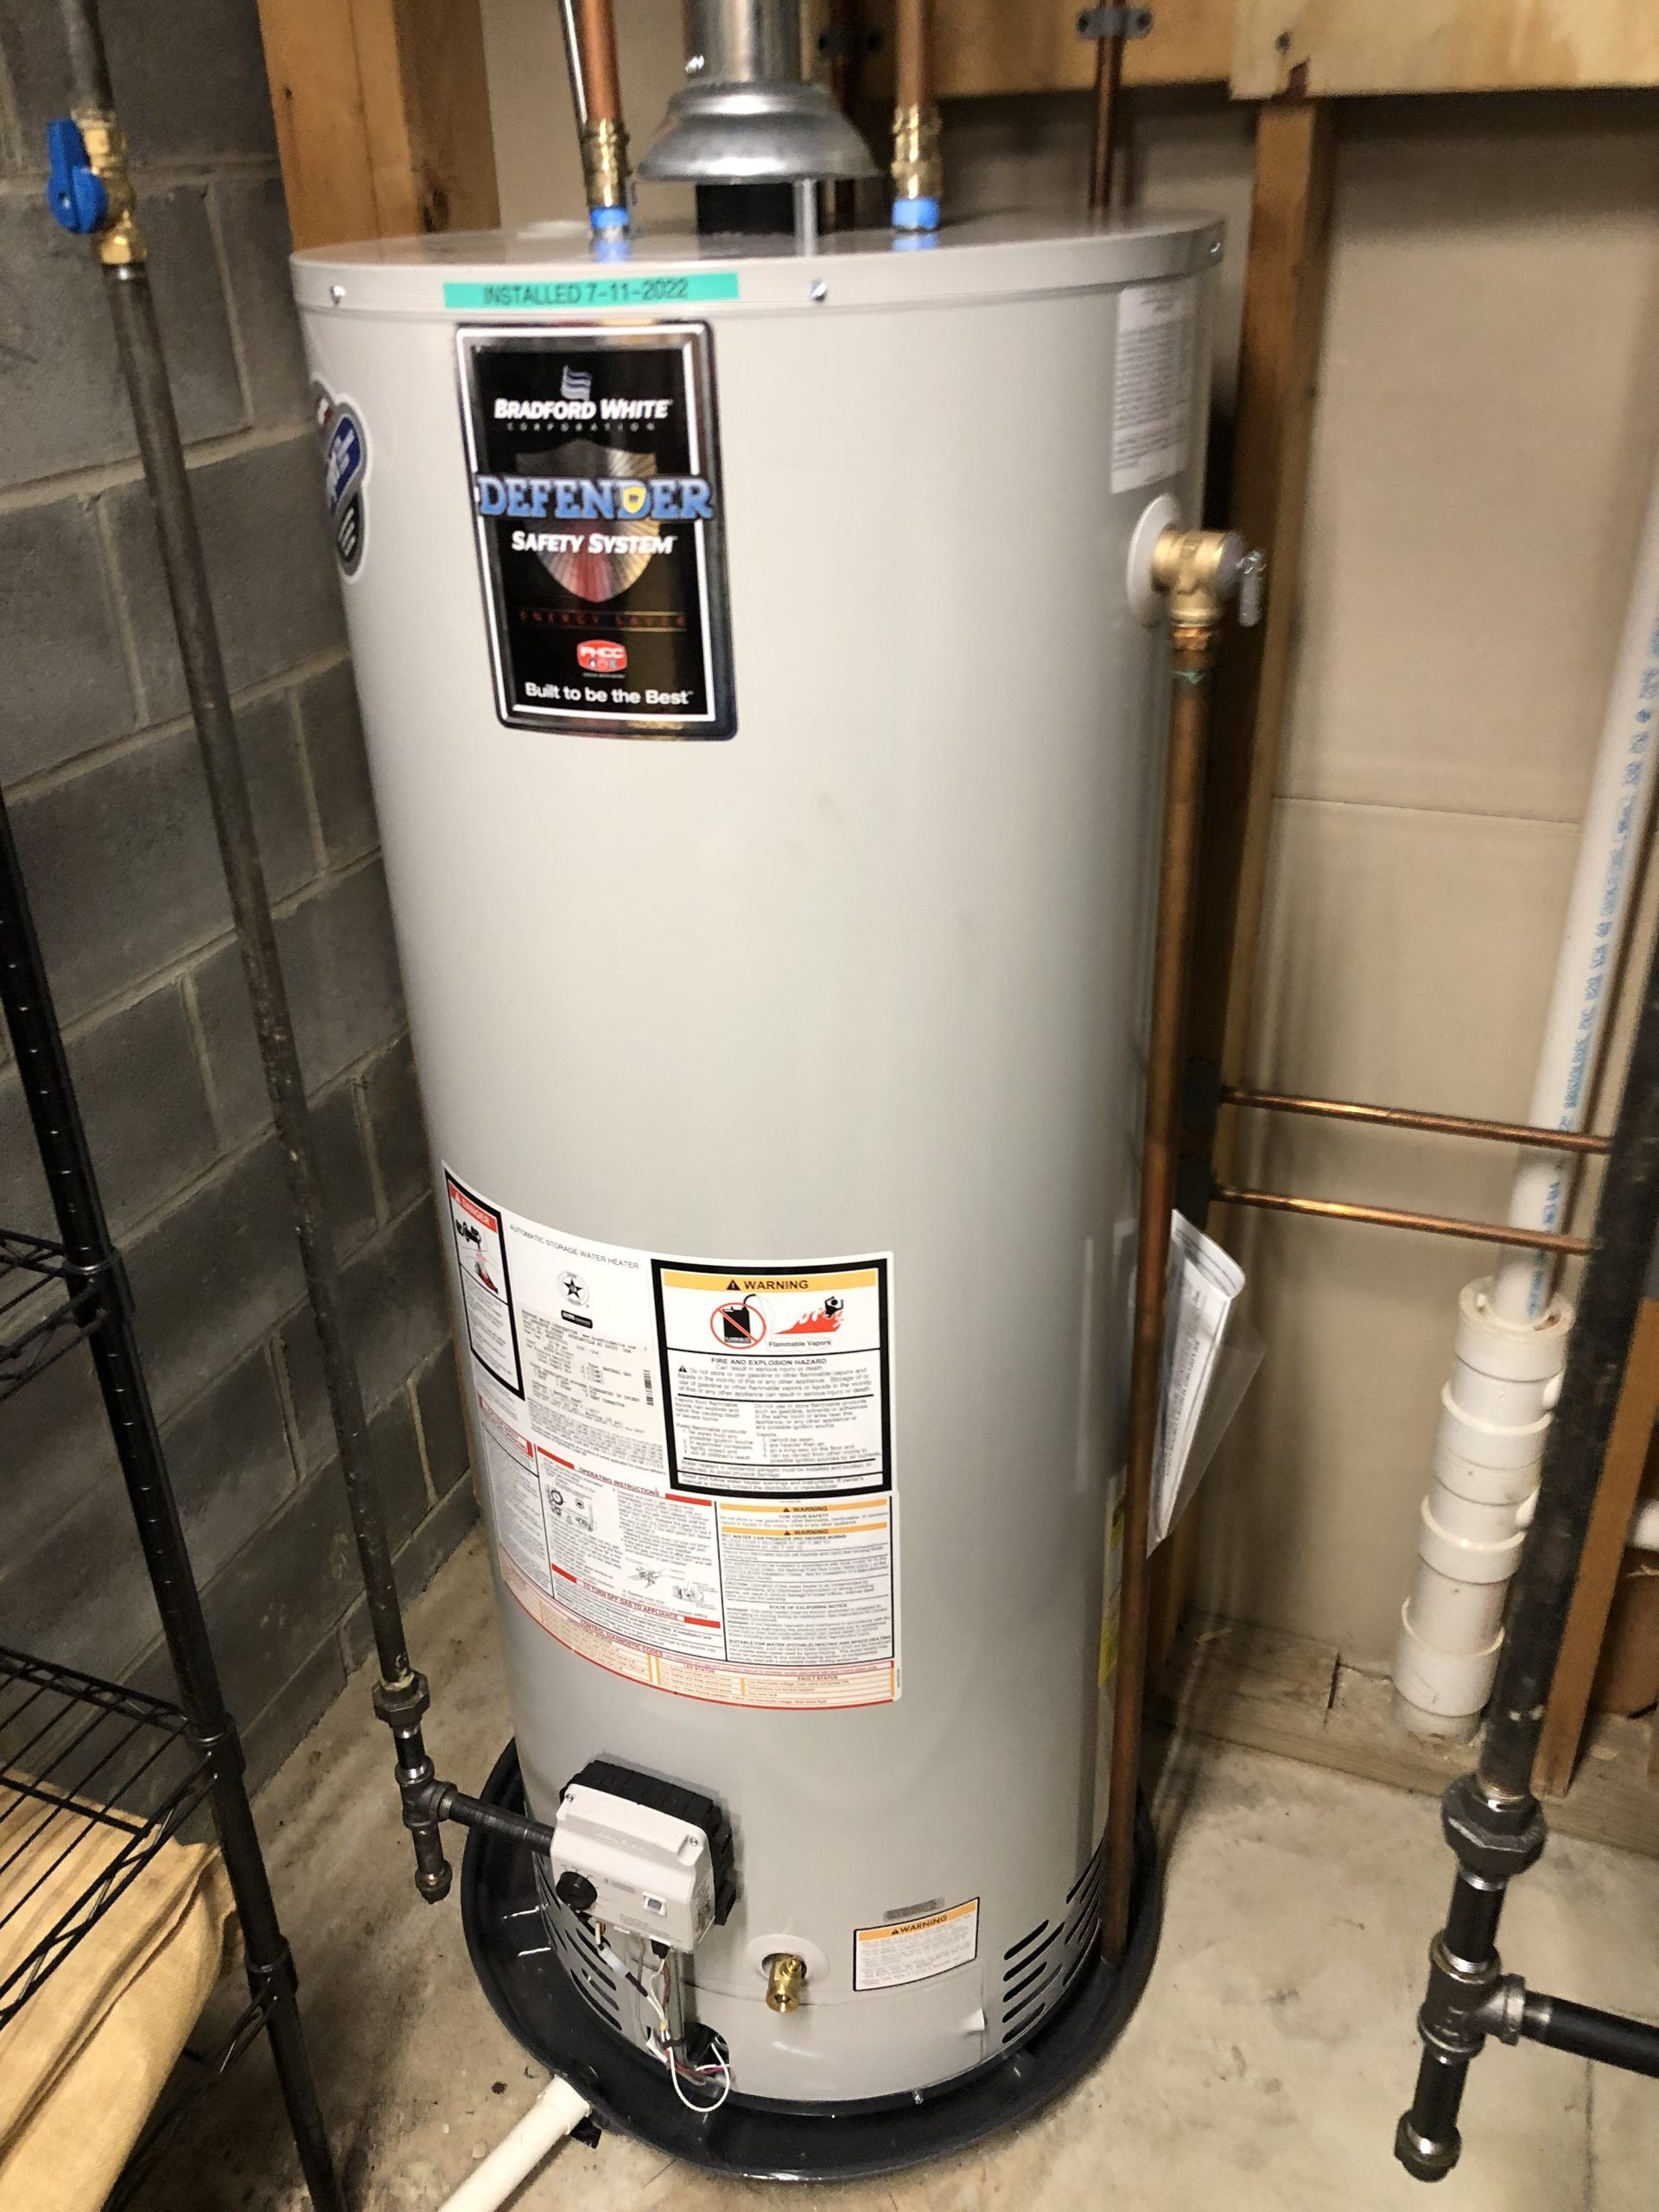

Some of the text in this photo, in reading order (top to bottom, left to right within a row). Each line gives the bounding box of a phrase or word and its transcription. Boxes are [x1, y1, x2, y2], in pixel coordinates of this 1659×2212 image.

[484, 278, 690, 305] INSTALLED 7-11-2022
[494, 398, 670, 421] BRADFORD WHITE
[478, 476, 713, 521] DEFENDER
[512, 531, 675, 555] SAFETY SYSTEM
[524, 682, 690, 706] Built to be the Best
[510, 1224, 639, 1268] AUTOMATIC STORAGE WATER HEATER
[744, 1280, 809, 1290] WARNING
[578, 1466, 613, 1484] OPERATING
[613, 1479, 660, 1497] INSTRUCTIONS
[643, 1605, 678, 1620] APPLIANCE
[899, 1915, 948, 1933] WARNING
